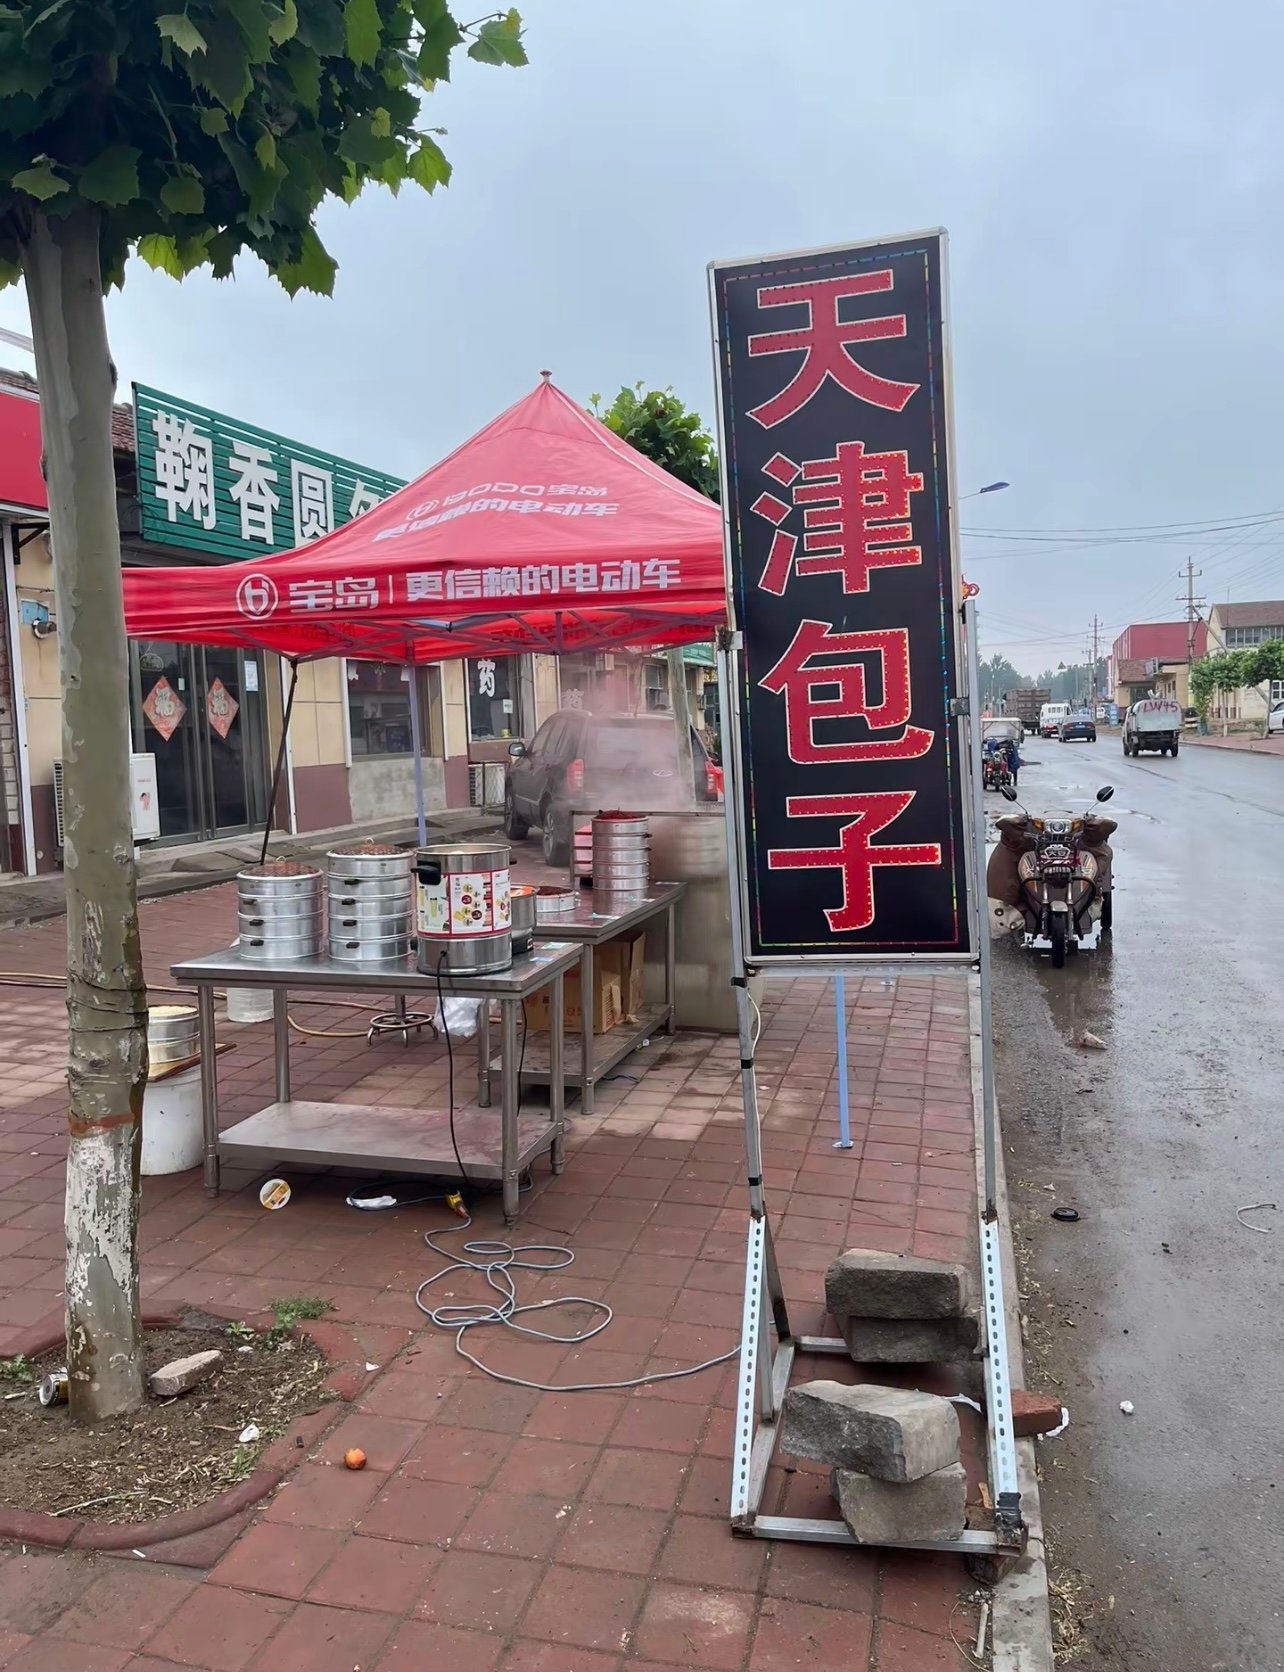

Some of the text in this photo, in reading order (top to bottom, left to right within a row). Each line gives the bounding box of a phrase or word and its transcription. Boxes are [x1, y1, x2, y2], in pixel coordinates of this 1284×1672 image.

[289, 576, 379, 613] 宝岛
[406, 558, 681, 601] 更信赖的电动车
[746, 269, 942, 933] 天津包子
